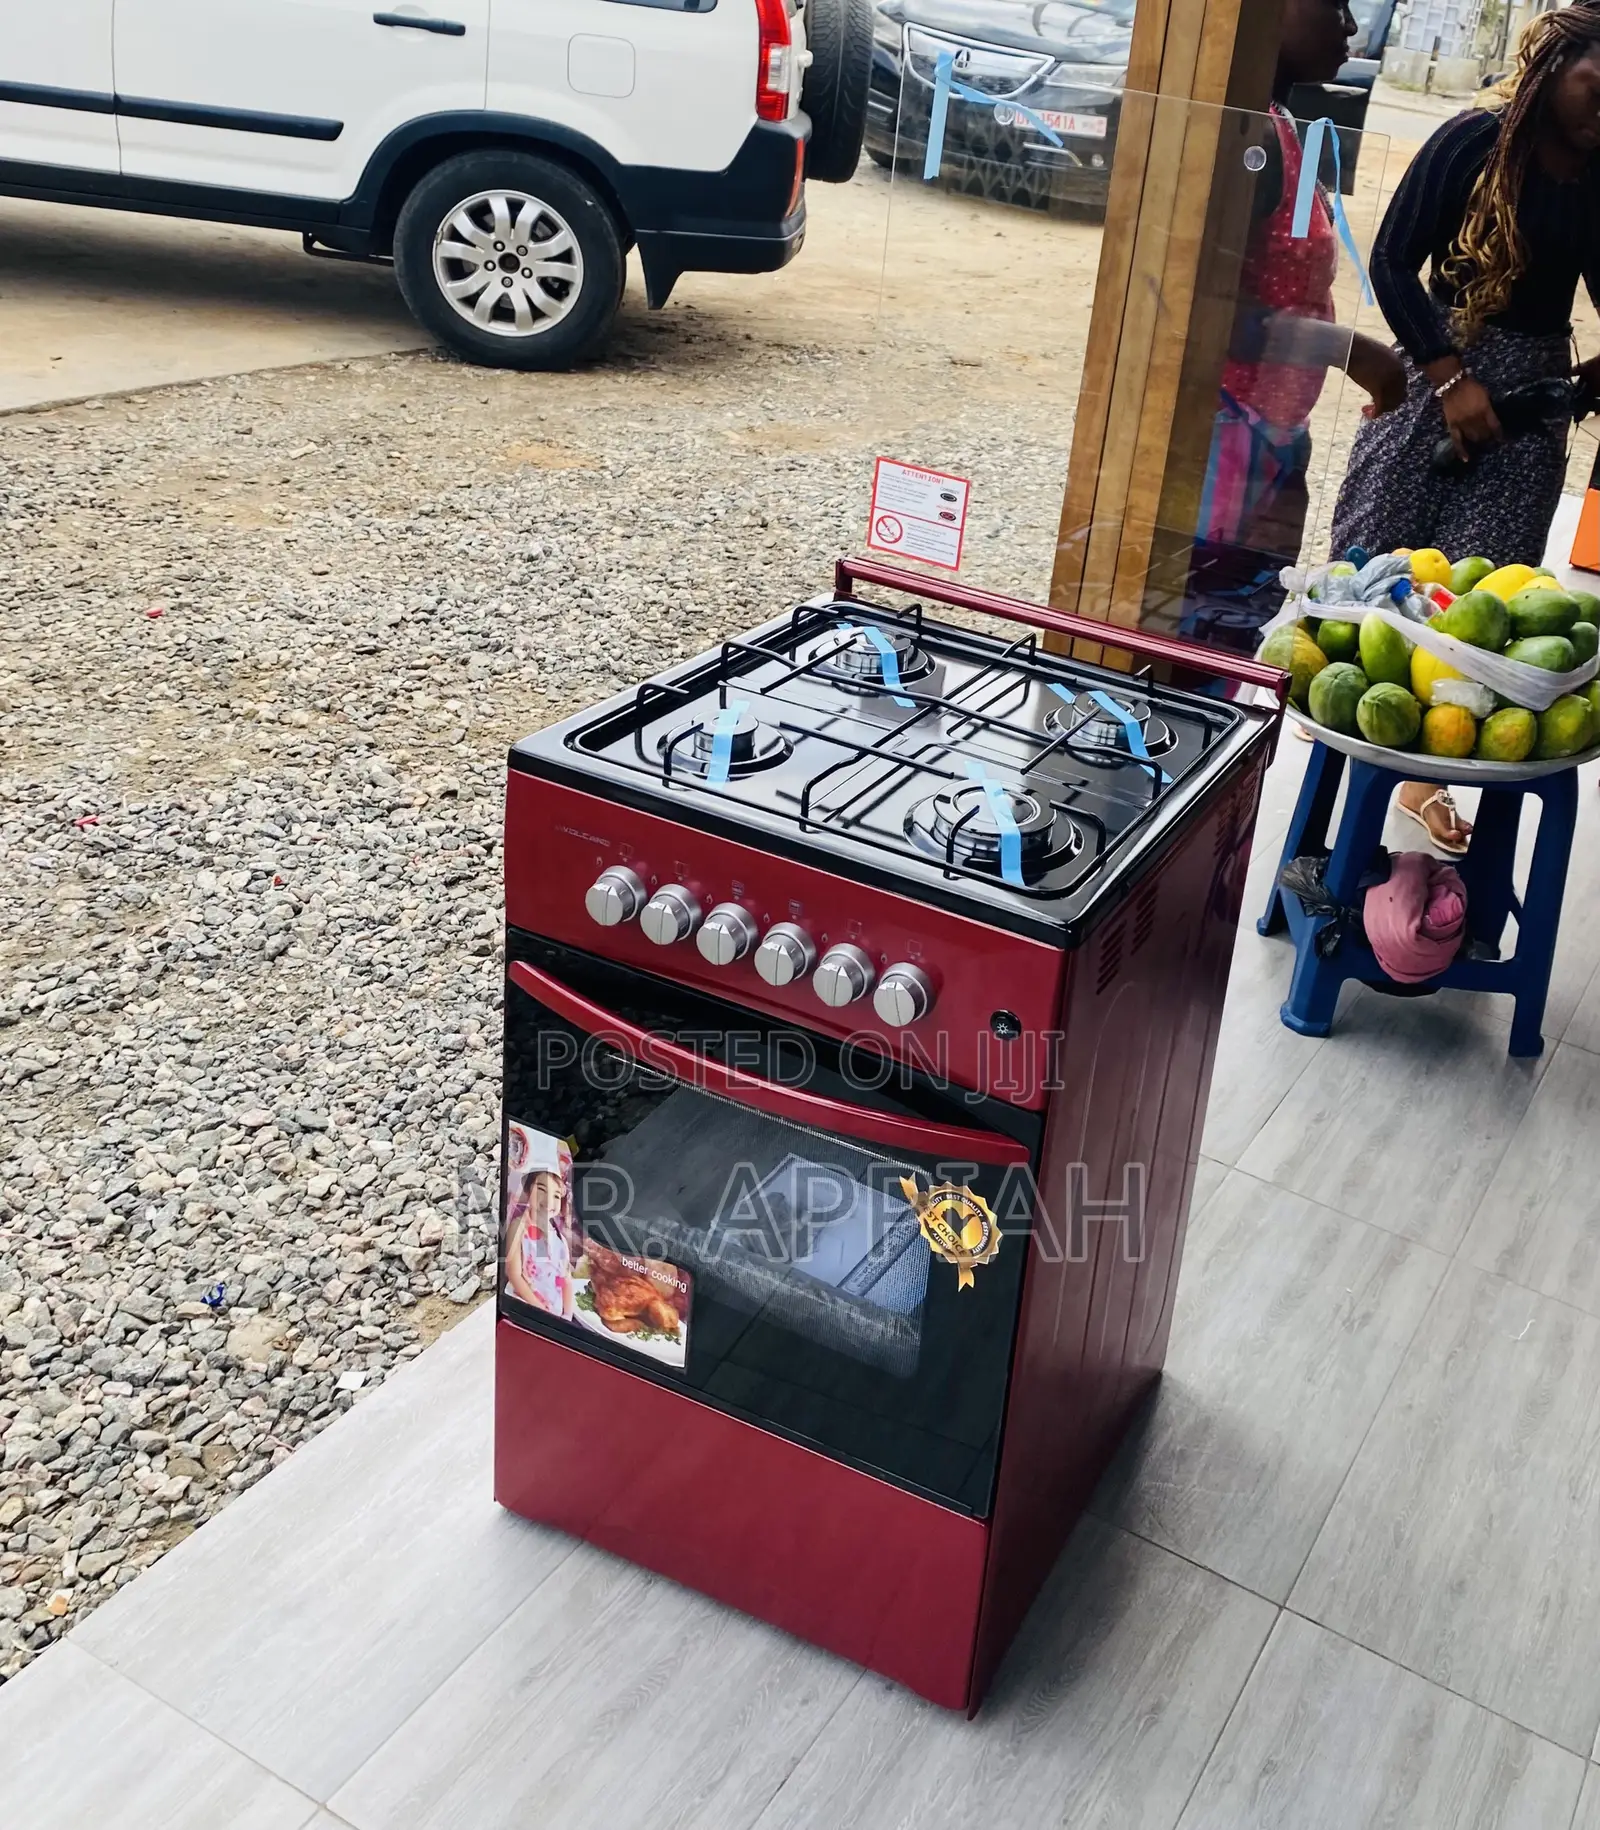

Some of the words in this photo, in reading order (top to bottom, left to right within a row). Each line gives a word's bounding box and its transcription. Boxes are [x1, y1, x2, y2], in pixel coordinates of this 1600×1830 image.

[902, 469, 944, 485] ATTENTION!
[961, 1197, 984, 1218] QUALITY
[937, 1223, 967, 1256] CHOICE
[622, 1257, 649, 1275] better
[651, 1270, 687, 1293] cooking
